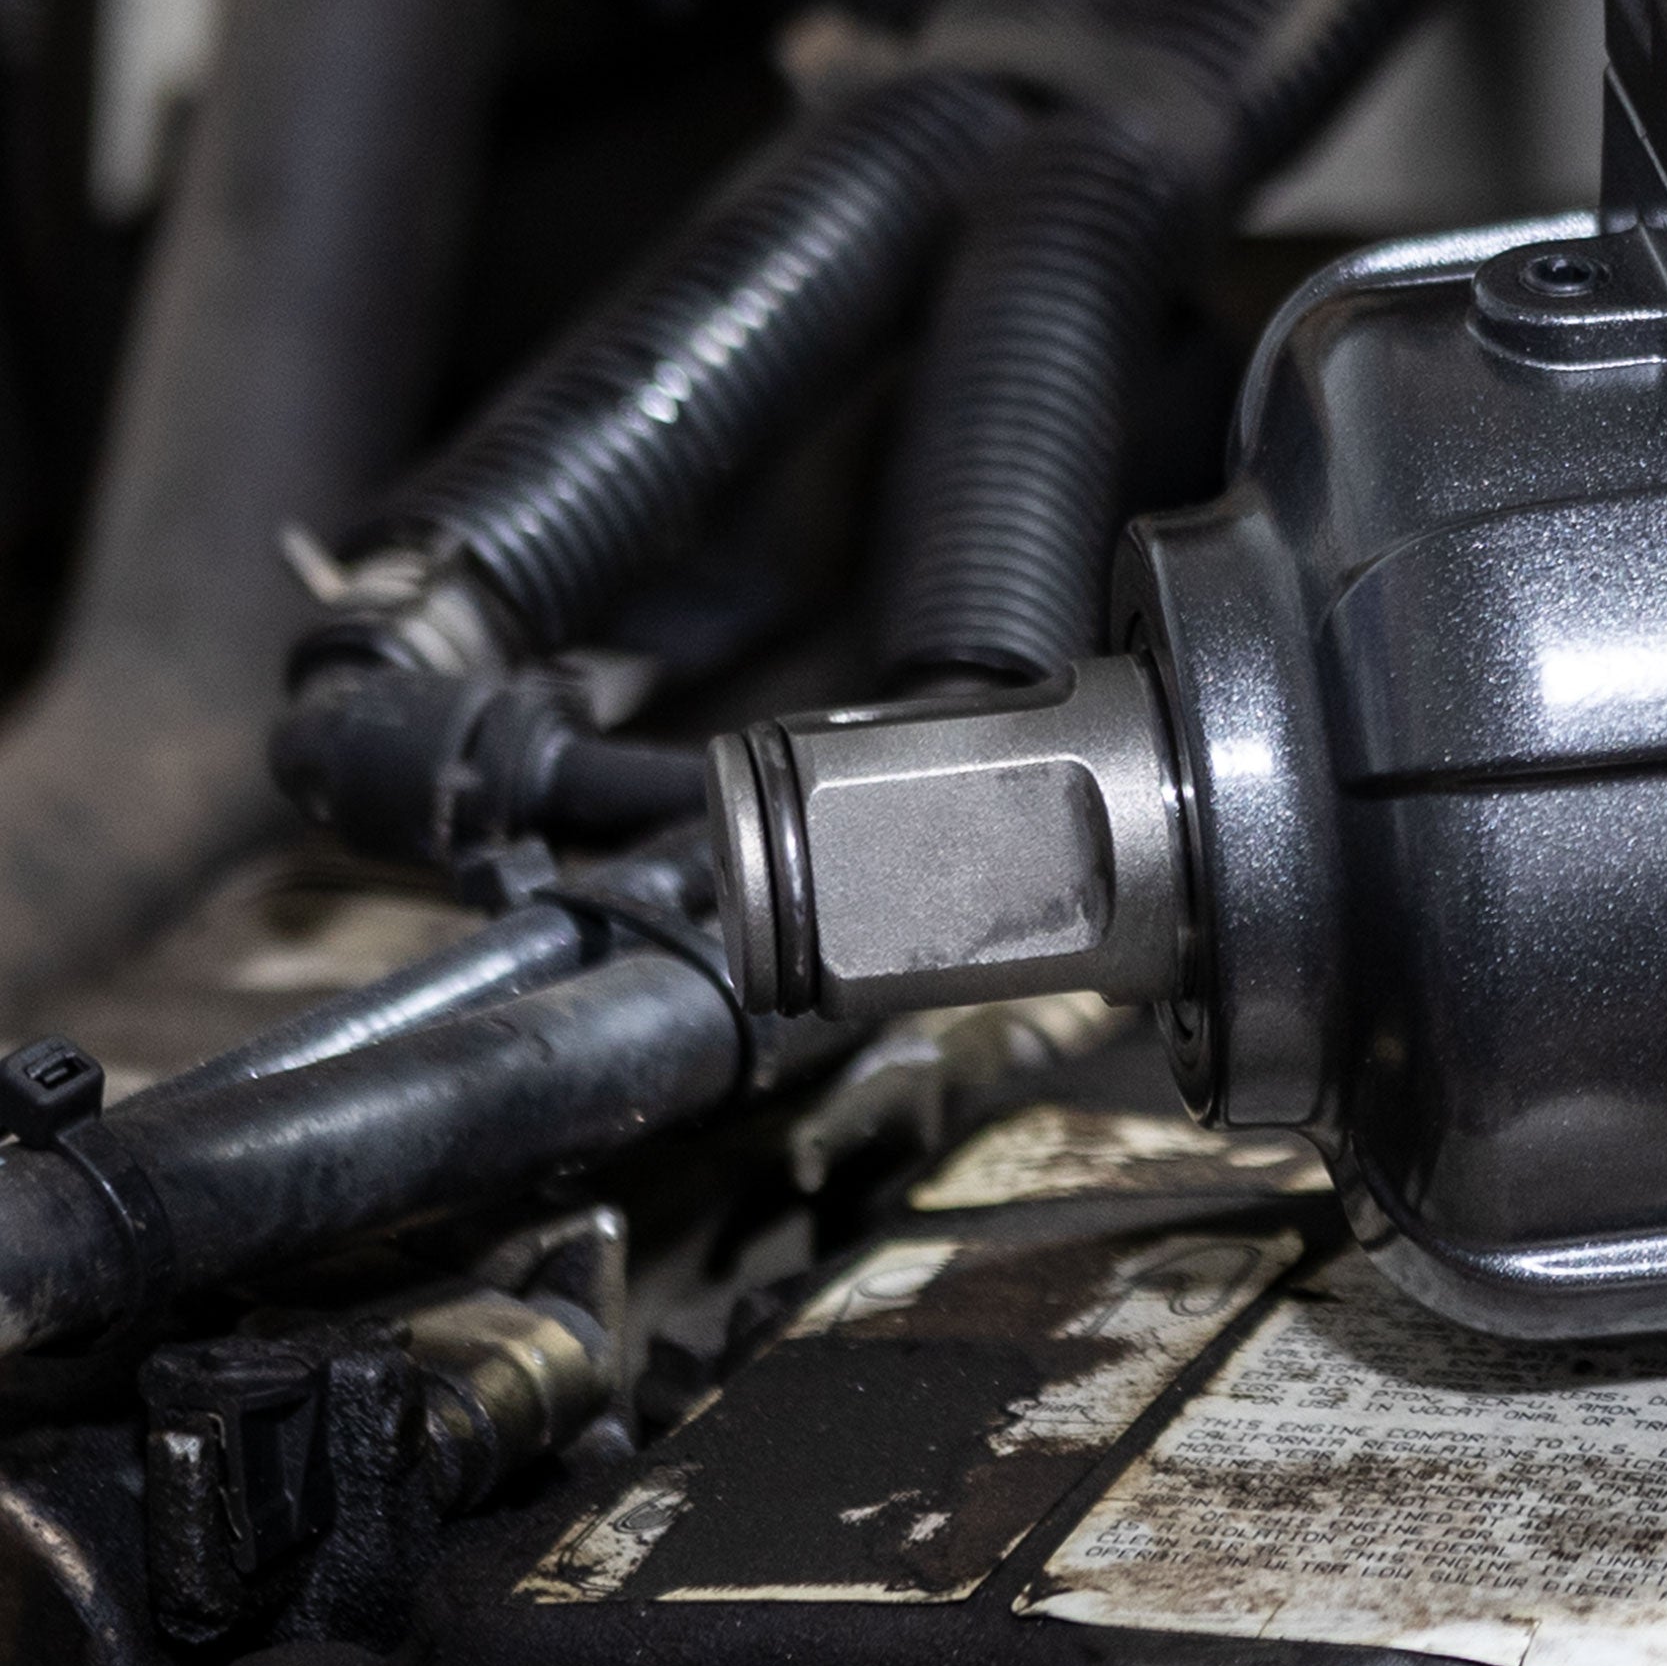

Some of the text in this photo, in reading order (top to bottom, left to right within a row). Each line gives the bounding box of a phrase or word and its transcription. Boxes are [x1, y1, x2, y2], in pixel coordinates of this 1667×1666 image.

[1294, 1398, 1345, 1410] USE
[1362, 1402, 1395, 1413] IN
[1405, 1402, 1570, 1425] VOCATONAL
[1578, 1415, 1617, 1427] OR
[1572, 1402, 1642, 1416] AMOX
[1184, 1426, 1349, 1450] CALIFORNIA
[1358, 1438, 1539, 1462] REGULATIONS
[1196, 1415, 1265, 1430] THIS
[1273, 1420, 1374, 1437] ENGINE
[1383, 1426, 1519, 1447] CONFORS
[1529, 1437, 1566, 1449] TO
[1575, 1441, 1642, 1455] U.S.
[1173, 1441, 1257, 1457] MODEL
[1268, 1447, 1337, 1462] YEAR
[1507, 1463, 1575, 1478] DUTY
[1494, 1474, 1554, 1489] HAS
[1380, 1493, 1433, 1507] NOT
[1445, 1498, 1596, 1520] CERTIFIED
[1606, 1512, 1663, 1526] FOR
[1536, 1491, 1622, 1507] HEAVY
[1246, 1512, 1317, 1528] THIS
[1325, 1518, 1435, 1537] ENGINE
[1440, 1527, 1495, 1541] FOR
[1336, 1504, 1457, 1524] DEFINED
[1465, 1514, 1503, 1527] AT
[1515, 1519, 1554, 1531] 40
[1106, 1518, 1145, 1531] IS
[1186, 1523, 1338, 1546] VIOLATION
[1346, 1536, 1379, 1548] OF
[1395, 1539, 1511, 1558] FEDERAL
[1093, 1532, 1181, 1548] CLEAN
[1339, 1550, 1410, 1565] THIS
[1417, 1555, 1518, 1573] ENGINE
[1536, 1565, 1574, 1578] IS
[1212, 1555, 1251, 1568] ON
[1259, 1558, 1351, 1576] ULTRA
[1358, 1566, 1416, 1581] LOW
[1424, 1571, 1531, 1589] SULFUR
[1538, 1581, 1641, 1599] DIESEL
